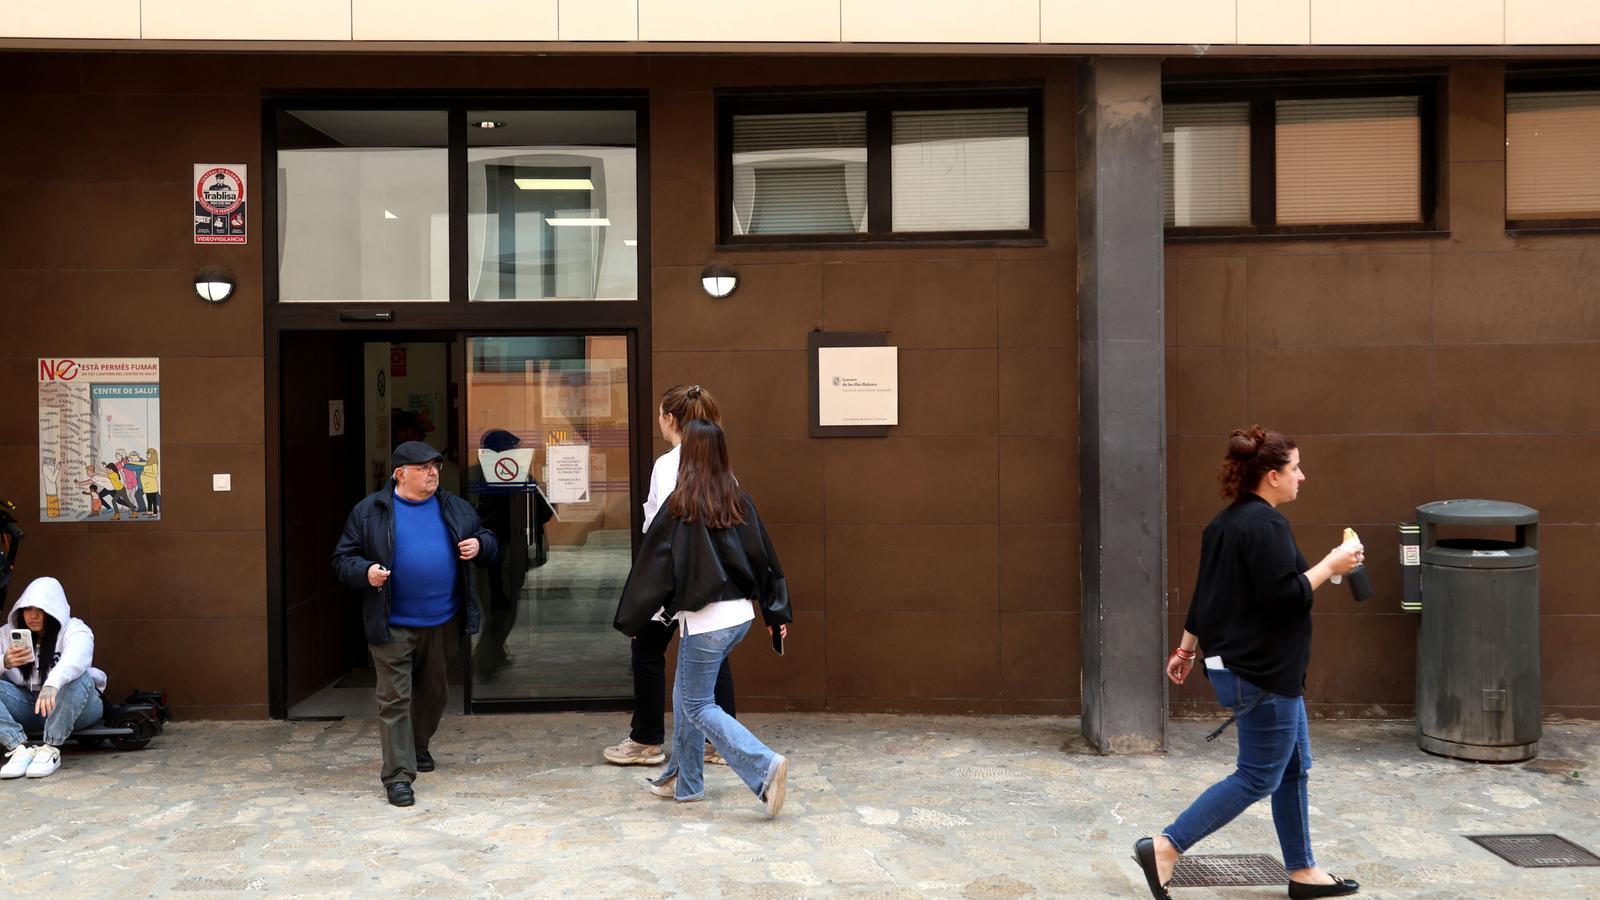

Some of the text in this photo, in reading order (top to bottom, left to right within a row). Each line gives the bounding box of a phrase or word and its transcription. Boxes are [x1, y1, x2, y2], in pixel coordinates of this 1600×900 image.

[203, 191, 236, 200] Trablisa
[82, 363, 99, 371] ESTÀ
[93, 387, 122, 395] CENTRE
[123, 387, 133, 395] DE
[134, 387, 158, 395] SALUT
